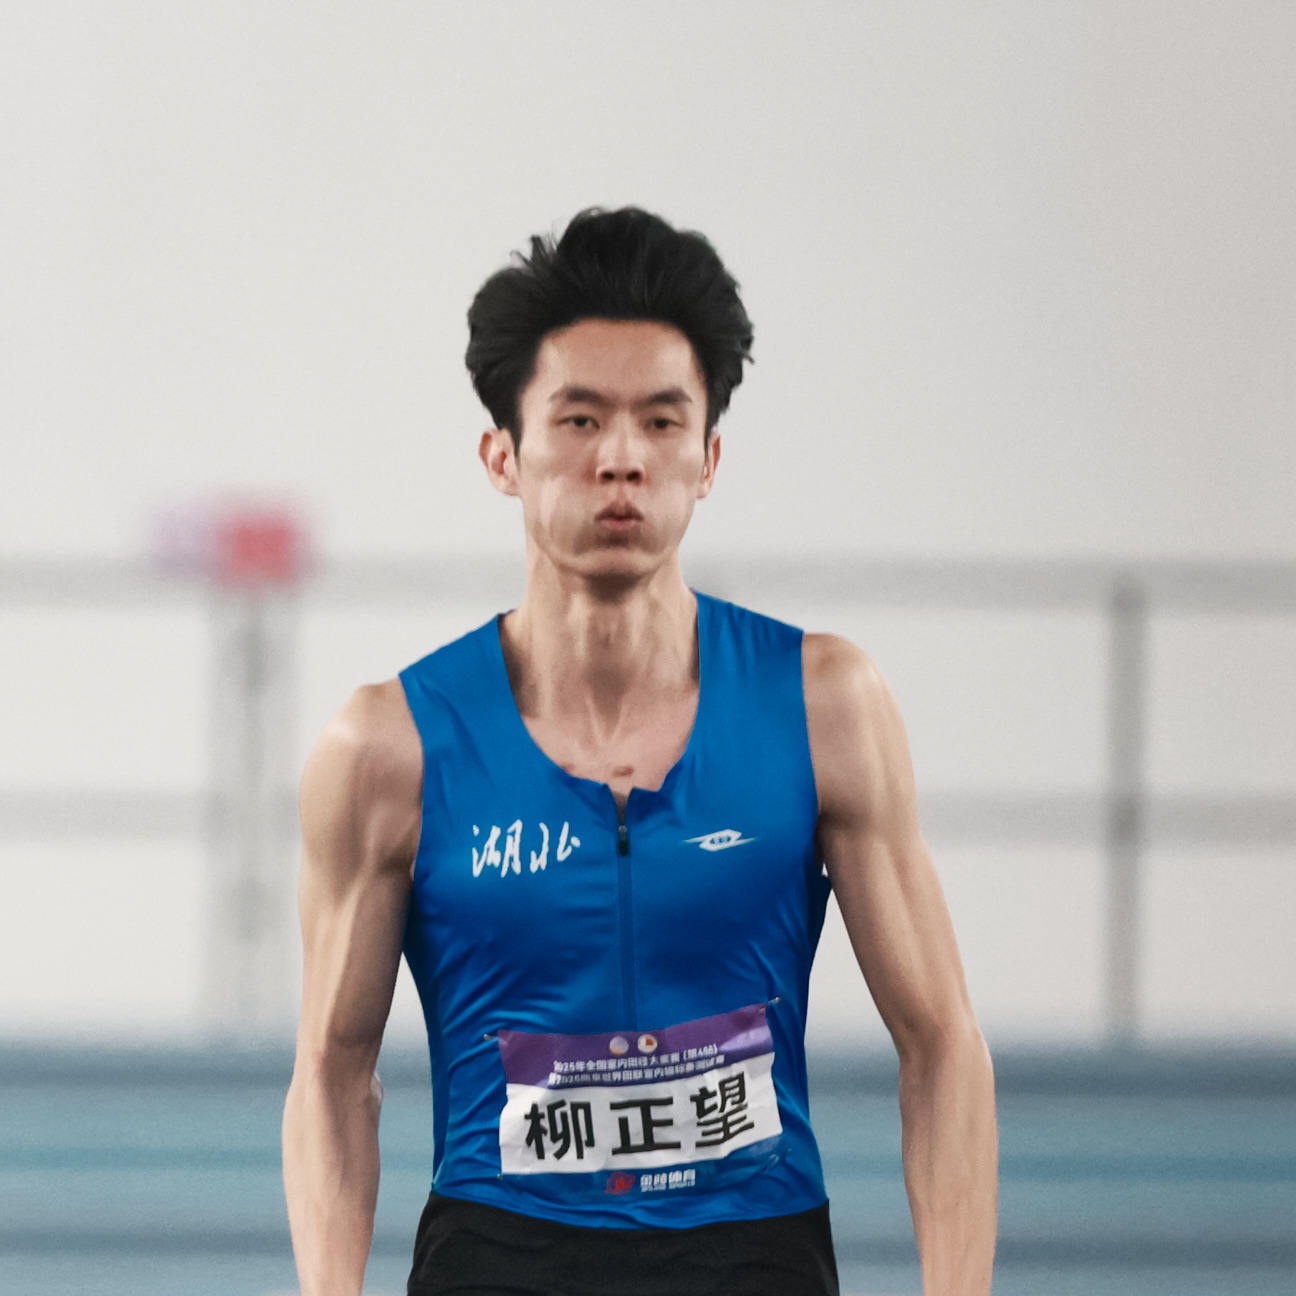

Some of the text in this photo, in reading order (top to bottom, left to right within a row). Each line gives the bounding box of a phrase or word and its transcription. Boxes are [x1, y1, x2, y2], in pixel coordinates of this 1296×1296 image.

[471, 817, 581, 878] 湖北
[524, 1071, 755, 1160] 柳正望
